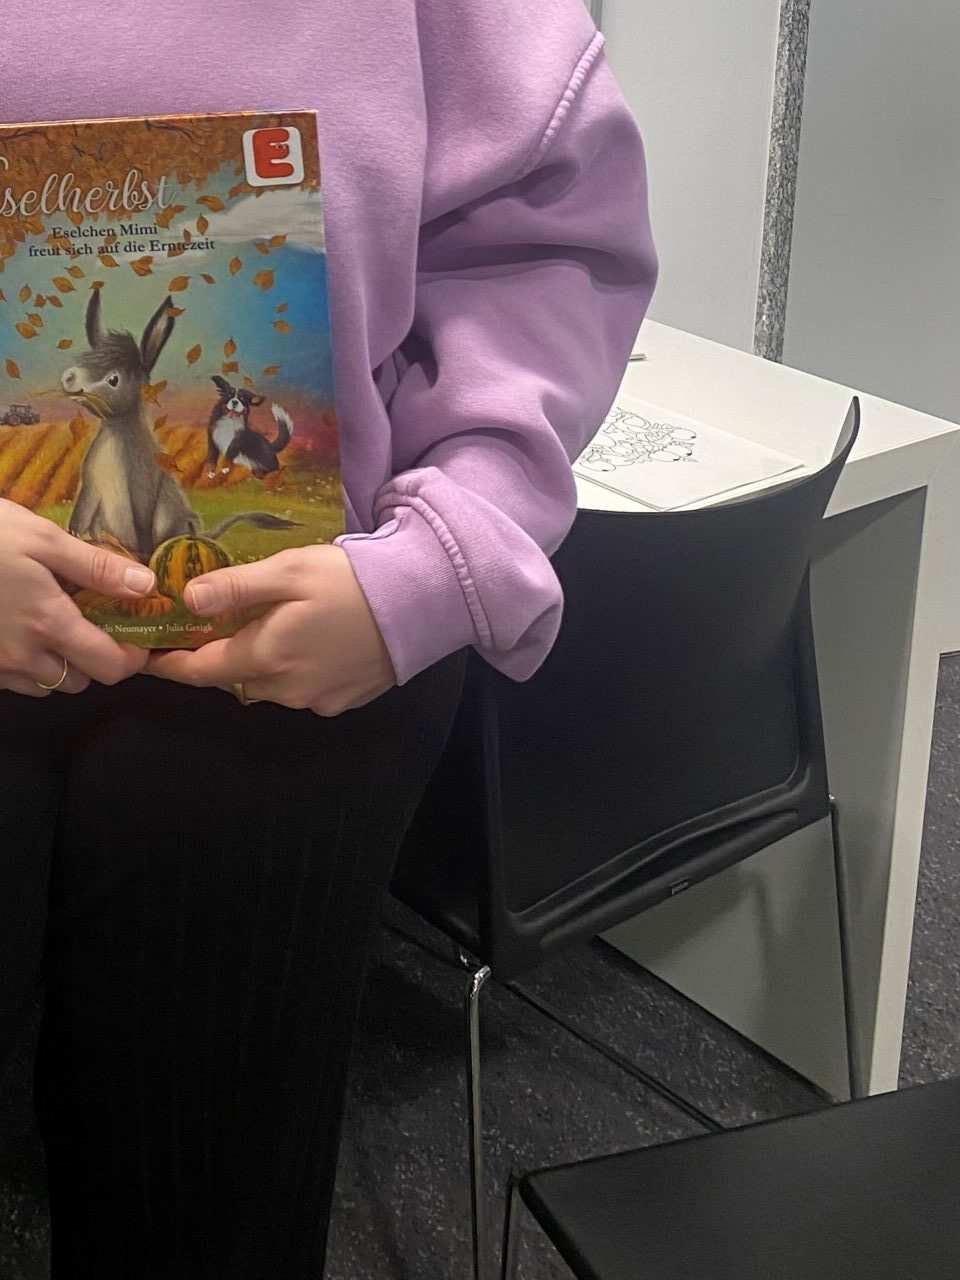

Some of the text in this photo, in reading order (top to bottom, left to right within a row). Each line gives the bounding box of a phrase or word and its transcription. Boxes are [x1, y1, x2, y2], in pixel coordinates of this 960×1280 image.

[252, 128, 294, 179] E
[52, 223, 158, 239] Eselchen Mimi
[29, 238, 216, 257] freut sich auf die Erntezeit
[115, 623, 157, 635] Neumayer
[166, 623, 184, 632] Julia
[185, 622, 214, 634] Gerigk
